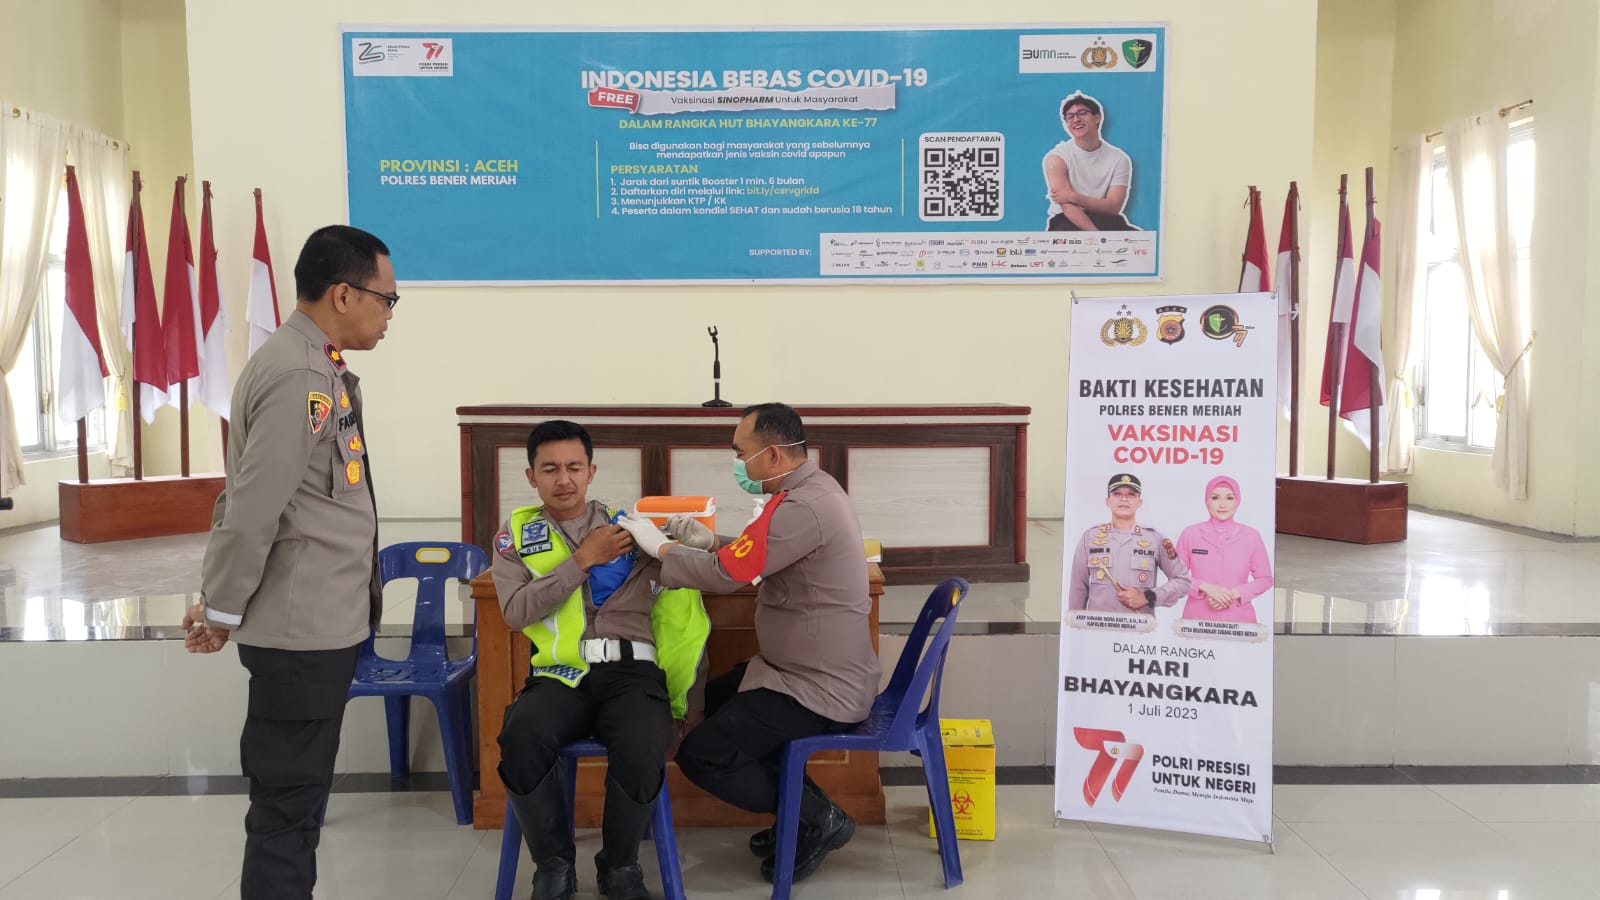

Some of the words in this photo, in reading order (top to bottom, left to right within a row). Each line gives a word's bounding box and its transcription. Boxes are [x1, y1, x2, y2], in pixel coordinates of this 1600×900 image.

[580, 70, 718, 89] INDONESIA
[722, 70, 802, 88] BEBAS
[807, 68, 928, 88] COVID-19
[598, 91, 634, 105] FREE
[670, 96, 715, 104] Vaksinasi
[717, 96, 774, 104] SINOPHARM
[804, 96, 858, 105] Masyarakat
[618, 119, 663, 129] DALAM
[664, 119, 717, 128] RANGKA
[719, 119, 744, 128] HUT
[746, 118, 840, 128] BHAYANGKARA
[842, 118, 878, 128] KE-77
[629, 142, 649, 150] Bisa
[650, 142, 702, 152] digunakan
[704, 142, 725, 151] bagi
[726, 141, 784, 152] masyarakat
[786, 142, 810, 151] yang
[812, 140, 871, 150] sebelumnya
[656, 150, 724, 160] mendapatkan
[724, 150, 748, 160] jenis
[748, 150, 780, 158] vaksin
[781, 150, 807, 158] covid
[808, 151, 846, 160] apapun
[380, 159, 460, 173] PROVINSI
[474, 159, 519, 173] ACEH
[610, 164, 699, 174] PERSYARATAN
[380, 175, 427, 185] POLRES
[430, 175, 468, 185] BENER
[470, 175, 517, 185] MERIAH
[620, 178, 648, 186] Jarak
[651, 178, 669, 186] dari
[671, 178, 700, 186] suntik
[702, 177, 739, 186] Booster
[768, 177, 775, 186] 6
[776, 176, 805, 186] bulan
[620, 187, 668, 196] Daftarkan
[670, 187, 685, 196] diri
[687, 187, 724, 196] melalui
[620, 197, 687, 207] Menunjukkan
[688, 197, 706, 206] KTP
[714, 197, 728, 206] KK
[622, 207, 658, 216] Peserta
[660, 206, 692, 216] dalam
[694, 206, 728, 216] kondisi
[730, 206, 760, 216] SEHAT
[761, 206, 780, 216] dan
[782, 206, 813, 216] sudah
[814, 206, 850, 216] berusia
[852, 206, 862, 214] 18
[864, 206, 893, 214] tahun
[1080, 380, 1136, 398] BAKTI
[1144, 378, 1264, 398] KESEHATAN
[1099, 404, 1145, 416] POLRES
[1149, 404, 1189, 416] BENER
[1192, 404, 1242, 416] MERIAH
[1107, 424, 1239, 443] VAKSINASI
[1114, 446, 1225, 466] COVID-19
[1113, 642, 1157, 656] DALAM
[1160, 646, 1216, 660] RANGKA
[1128, 658, 1190, 678] HARI
[1064, 676, 1259, 708] BHAYANGKARA
[1127, 704, 1134, 714] 1
[1139, 704, 1161, 718] Juli
[1165, 706, 1198, 720] 2023
[1152, 754, 1194, 771] POLRI
[1197, 758, 1250, 777] PRESISI
[1152, 771, 1200, 788] UNTUK
[1205, 778, 1256, 795] NEGERI
